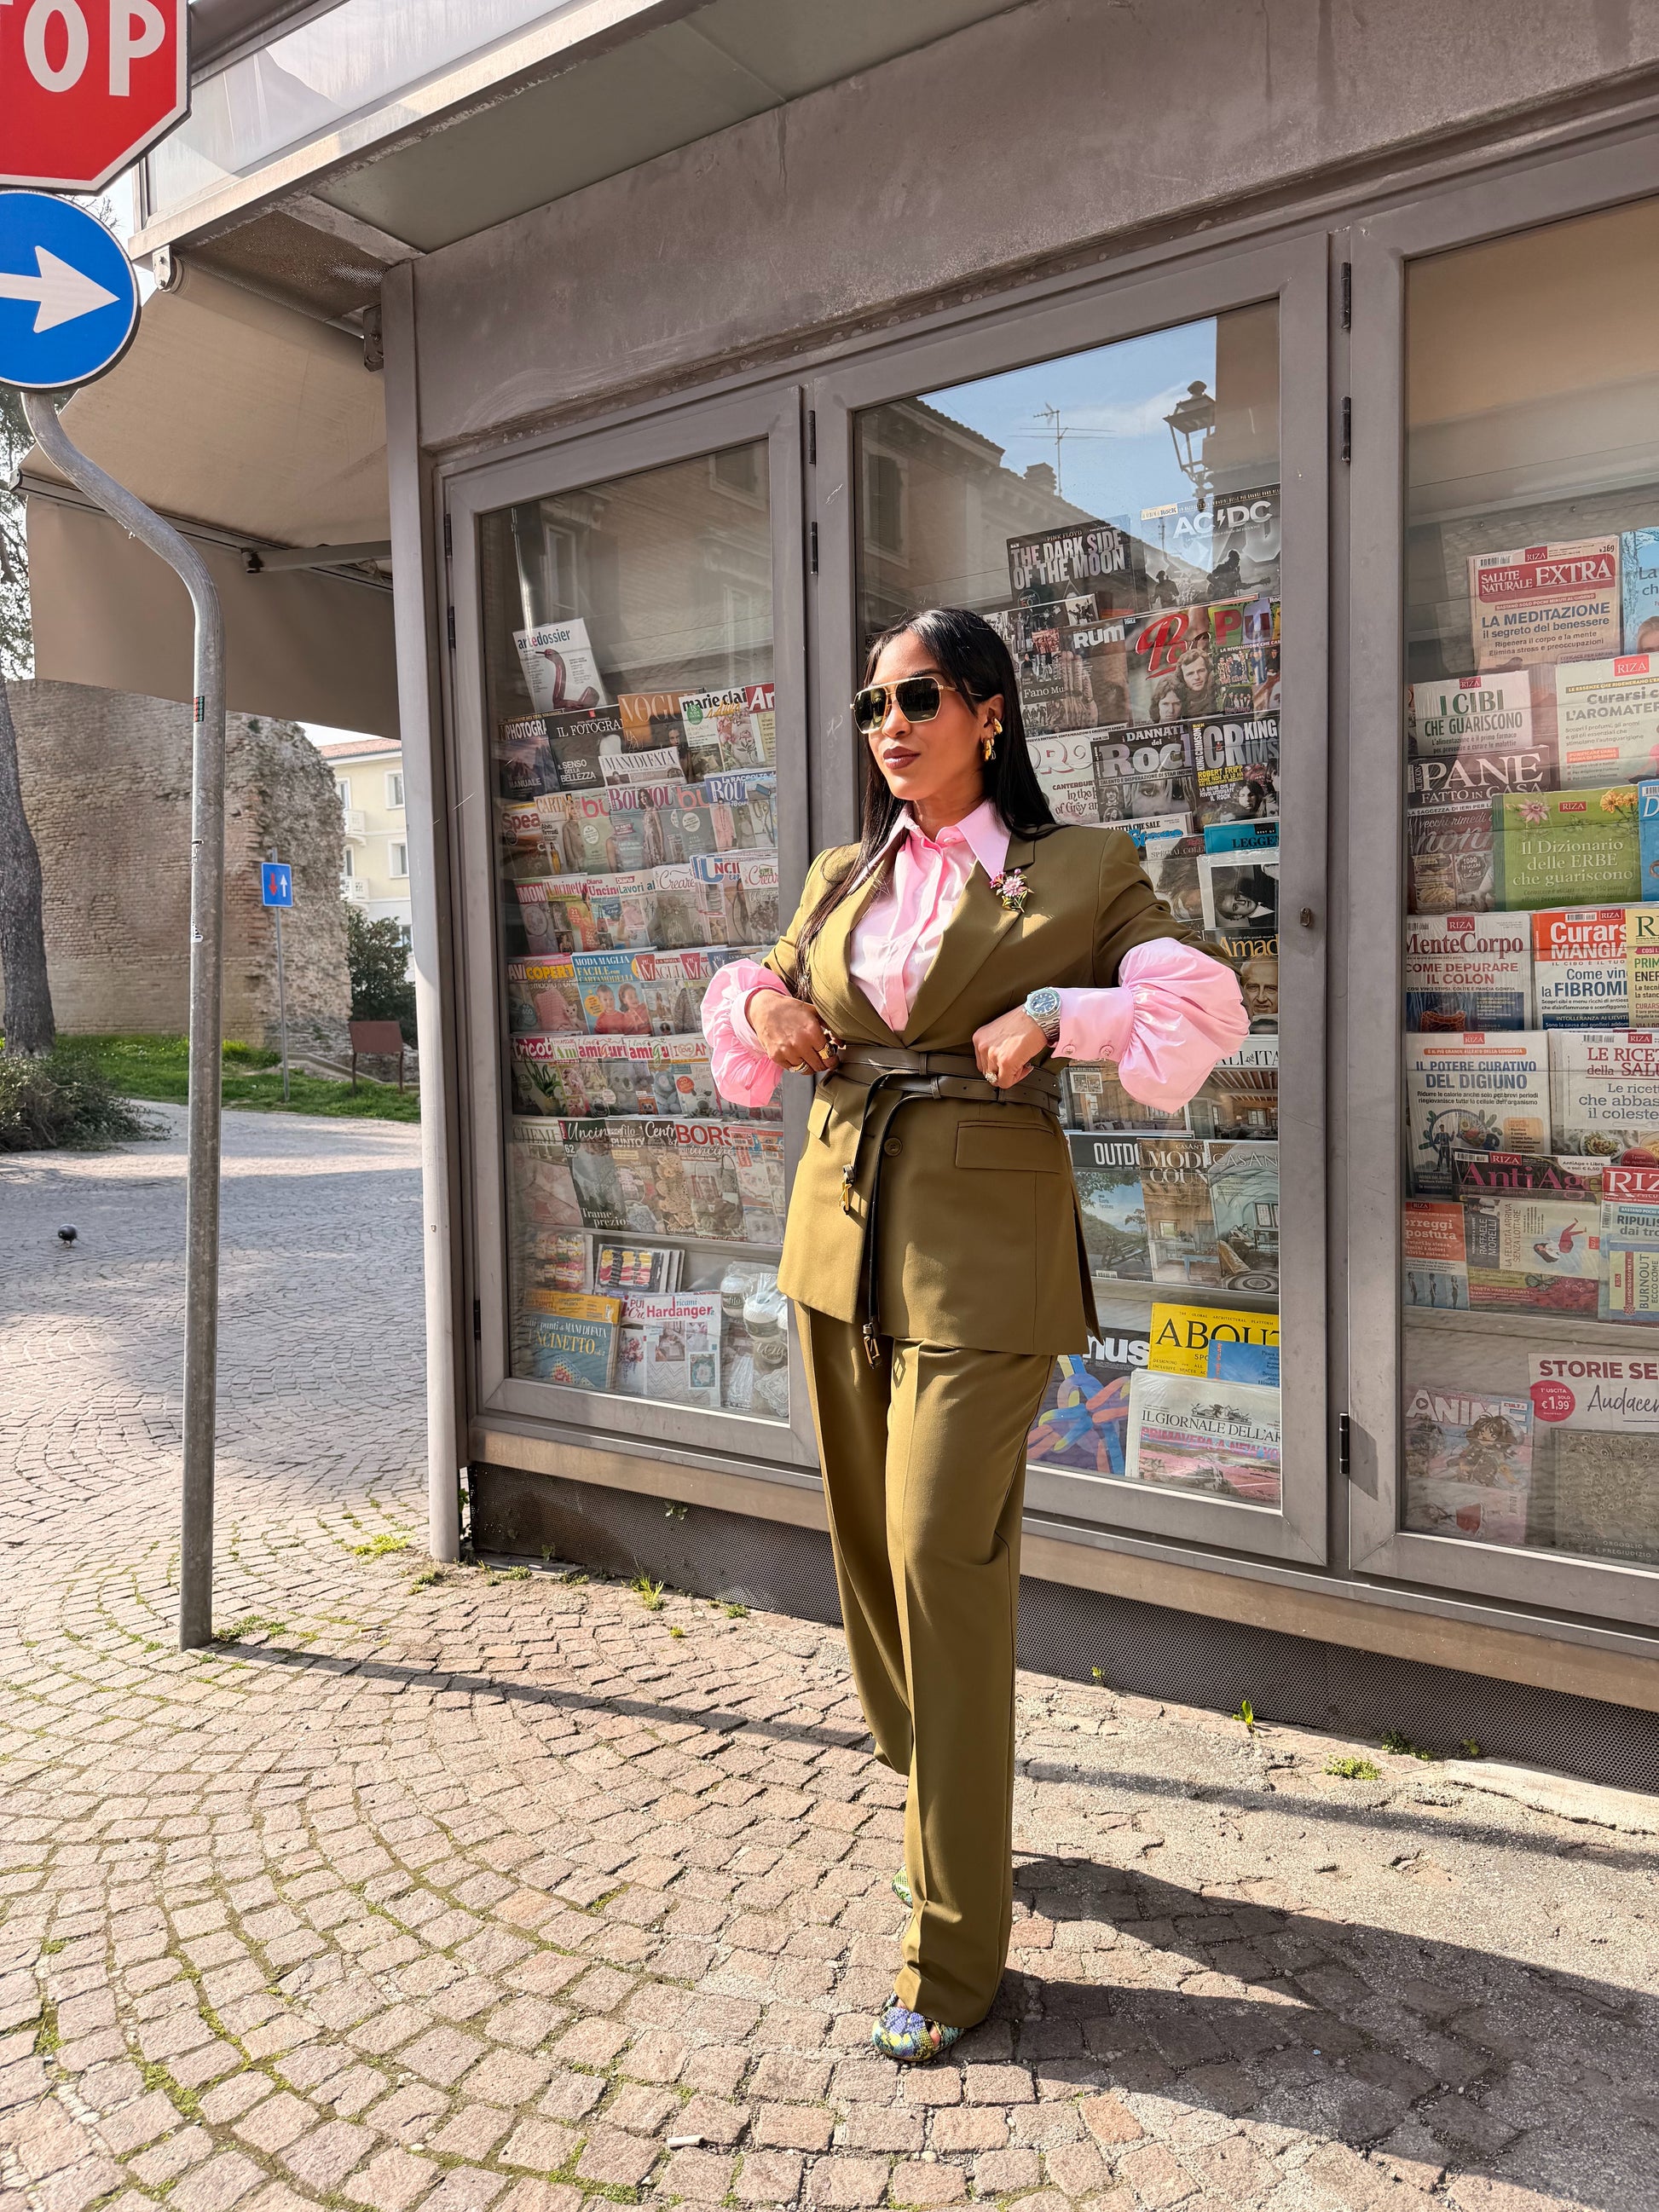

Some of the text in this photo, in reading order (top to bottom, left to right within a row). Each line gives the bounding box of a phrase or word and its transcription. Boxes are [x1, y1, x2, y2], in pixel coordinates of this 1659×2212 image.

[0, 0, 165, 96] OP
[1011, 529, 1122, 567] THE DARK SIDE
[1526, 552, 1546, 562] RIZA
[1013, 544, 1125, 590] OF THE MOON
[1535, 559, 1612, 587] EXTRA
[1639, 566, 1657, 580] La
[1481, 570, 1520, 584] SALUTE
[1482, 579, 1533, 594] NATURALE
[1482, 602, 1610, 628] LA MEDITAZIONE
[1492, 616, 1610, 639] segreto del benessere
[517, 629, 570, 650] artedossier
[1489, 638, 1604, 656] Elimina stress preoccupazioni
[1494, 638, 1527, 649] Rigenera
[1535, 635, 1557, 646] corpo
[1227, 644, 1260, 652] RIVOLUZIONE
[1617, 661, 1647, 674] RIZA
[1460, 679, 1481, 689] RIZA
[1024, 687, 1049, 699] Fano
[1587, 686, 1646, 704] Curarsi
[683, 694, 720, 712] marie
[1440, 690, 1504, 716] I CIBI
[1566, 702, 1659, 721] L'AROMATER
[557, 719, 623, 737] IL FOTOGRA
[1244, 719, 1278, 741] KING
[1425, 712, 1523, 736] CHE GUARISCONO
[1126, 725, 1184, 742] DANNATI
[1194, 727, 1205, 771] KING CRIMSON
[563, 759, 587, 769] SENSO
[1198, 765, 1243, 777] ROBERT FRIPP
[561, 771, 596, 783] BELLEZZA
[1124, 773, 1158, 783] DISPERAZIONE
[1419, 753, 1544, 792] PANE
[1421, 790, 1470, 804] FATTO
[1562, 803, 1585, 811] RIZA
[1522, 838, 1624, 855] Il Dizionario
[1527, 853, 1618, 871] delle ERBE
[1512, 869, 1633, 888] che guariscono
[619, 882, 645, 894] Lavori
[575, 956, 630, 967] MODA MAGLIA
[1407, 962, 1518, 973] COME DEPURARE
[576, 967, 609, 976] FACILE
[1427, 973, 1494, 985] IL COLON
[1567, 968, 1603, 980] Come
[1541, 981, 1627, 997] la FIBROMI
[512, 1037, 553, 1061] tricot
[1587, 1047, 1609, 1061] LE
[1416, 1060, 1537, 1071] IL POTERE CURATIVO
[1587, 1065, 1614, 1076] della
[1425, 1073, 1528, 1089] DEL DIGIUNO
[1608, 1083, 1623, 1093] Le
[1579, 1094, 1607, 1106] che
[1588, 1107, 1659, 1120] il coleste
[675, 1124, 731, 1146] BORS
[564, 1145, 575, 1153] 62
[1493, 1156, 1520, 1164] RIZA
[581, 1207, 612, 1218] Trame
[1406, 1228, 1458, 1241] postura
[1479, 1218, 1488, 1255] RAFFAELE
[1488, 1218, 1498, 1256] MORELLI
[1503, 1203, 1512, 1257] FELICITÀ ARRIVA
[1621, 1226, 1640, 1236] dai
[1639, 1254, 1650, 1309] BURNOUT
[646, 1296, 712, 1320] Hardanger
[676, 1298, 697, 1307] ricami
[1540, 1360, 1659, 1380] STORIE SE
[1548, 1395, 1569, 1411] 1,99
[1142, 1410, 1154, 1422] IL
[1155, 1412, 1226, 1434] GIORNALE
[1141, 1426, 1213, 1445] PRIMAVERA
[1602, 1540, 1644, 1550] ORGOGLIO
[1602, 1548, 1652, 1559] PREGIUDIZIO
